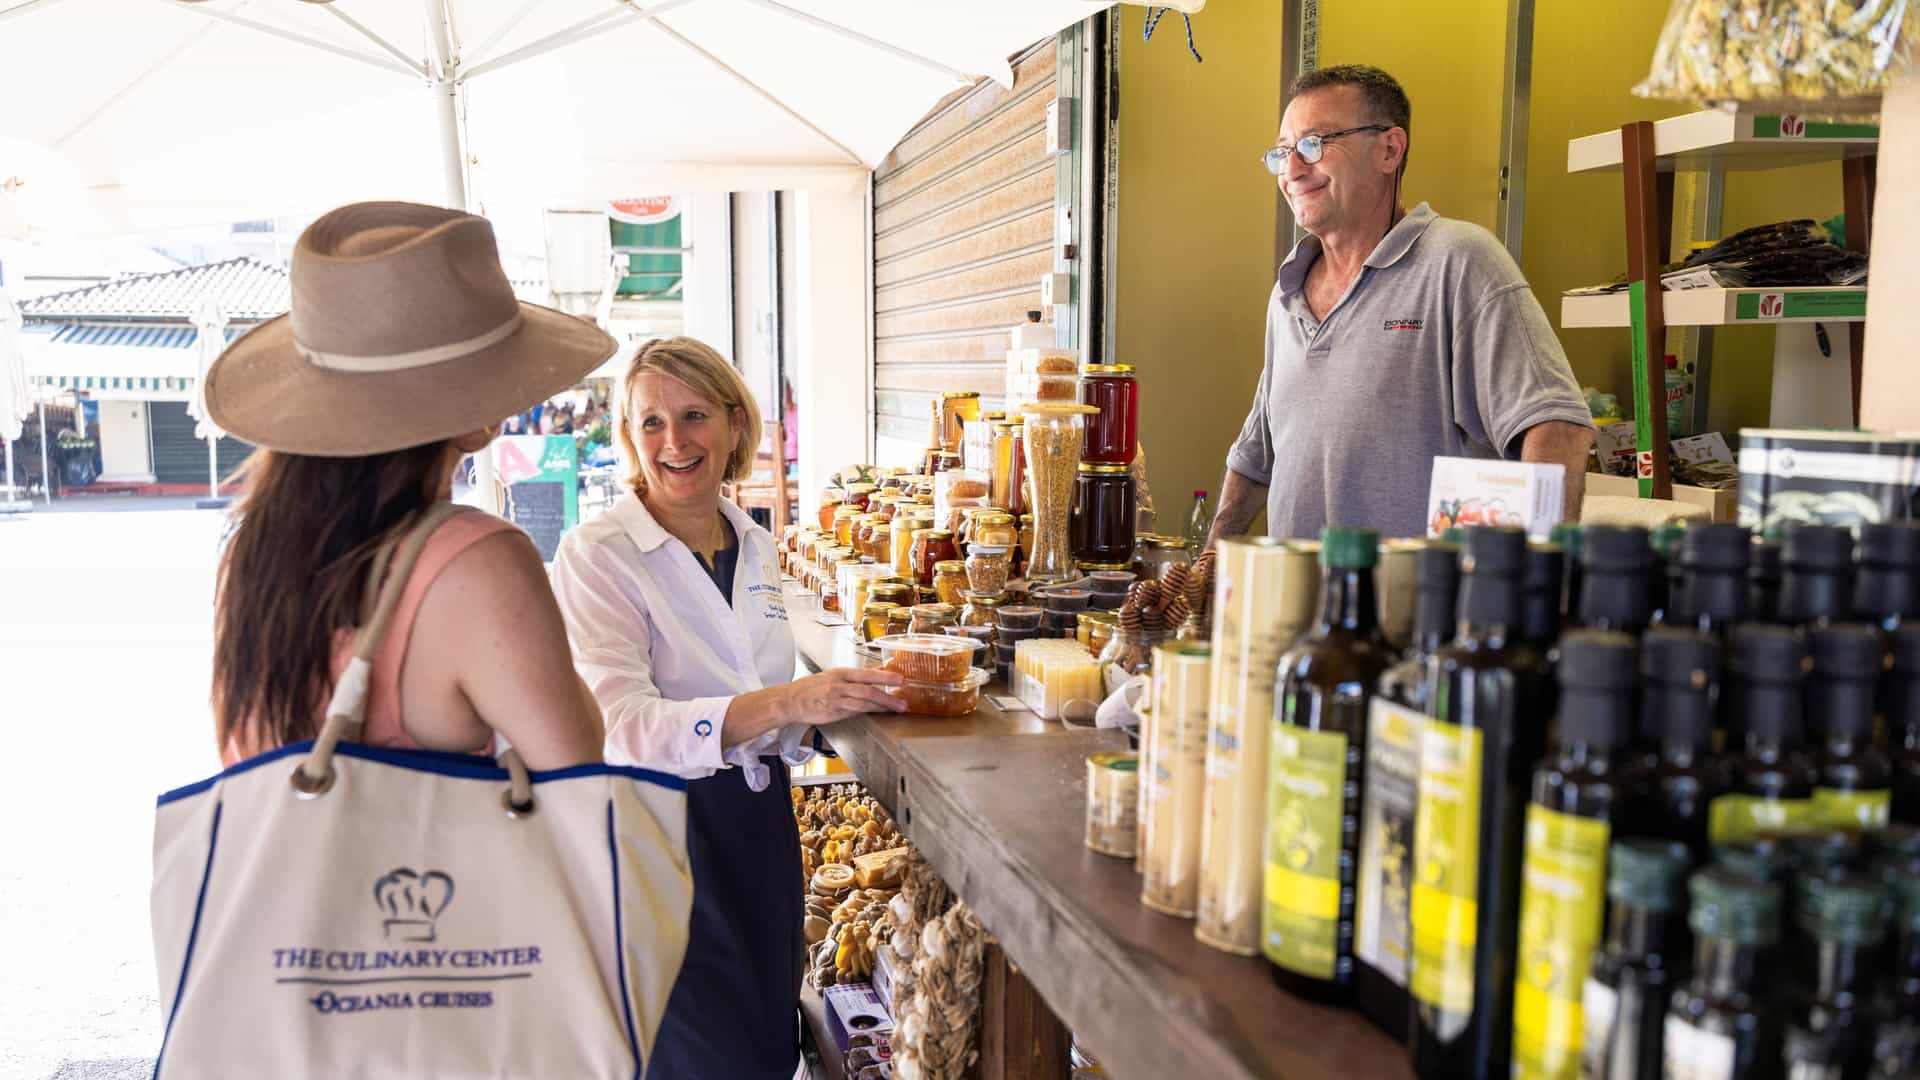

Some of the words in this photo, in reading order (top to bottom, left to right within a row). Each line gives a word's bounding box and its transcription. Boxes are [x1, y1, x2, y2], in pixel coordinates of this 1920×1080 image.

[1383, 319, 1424, 327] DONNAY
[273, 948, 322, 969] THE
[325, 949, 448, 971] CULINARY
[449, 946, 542, 968] CENTER
[310, 990, 413, 1014] OCEANIA
[418, 991, 494, 1009] CRUISES
